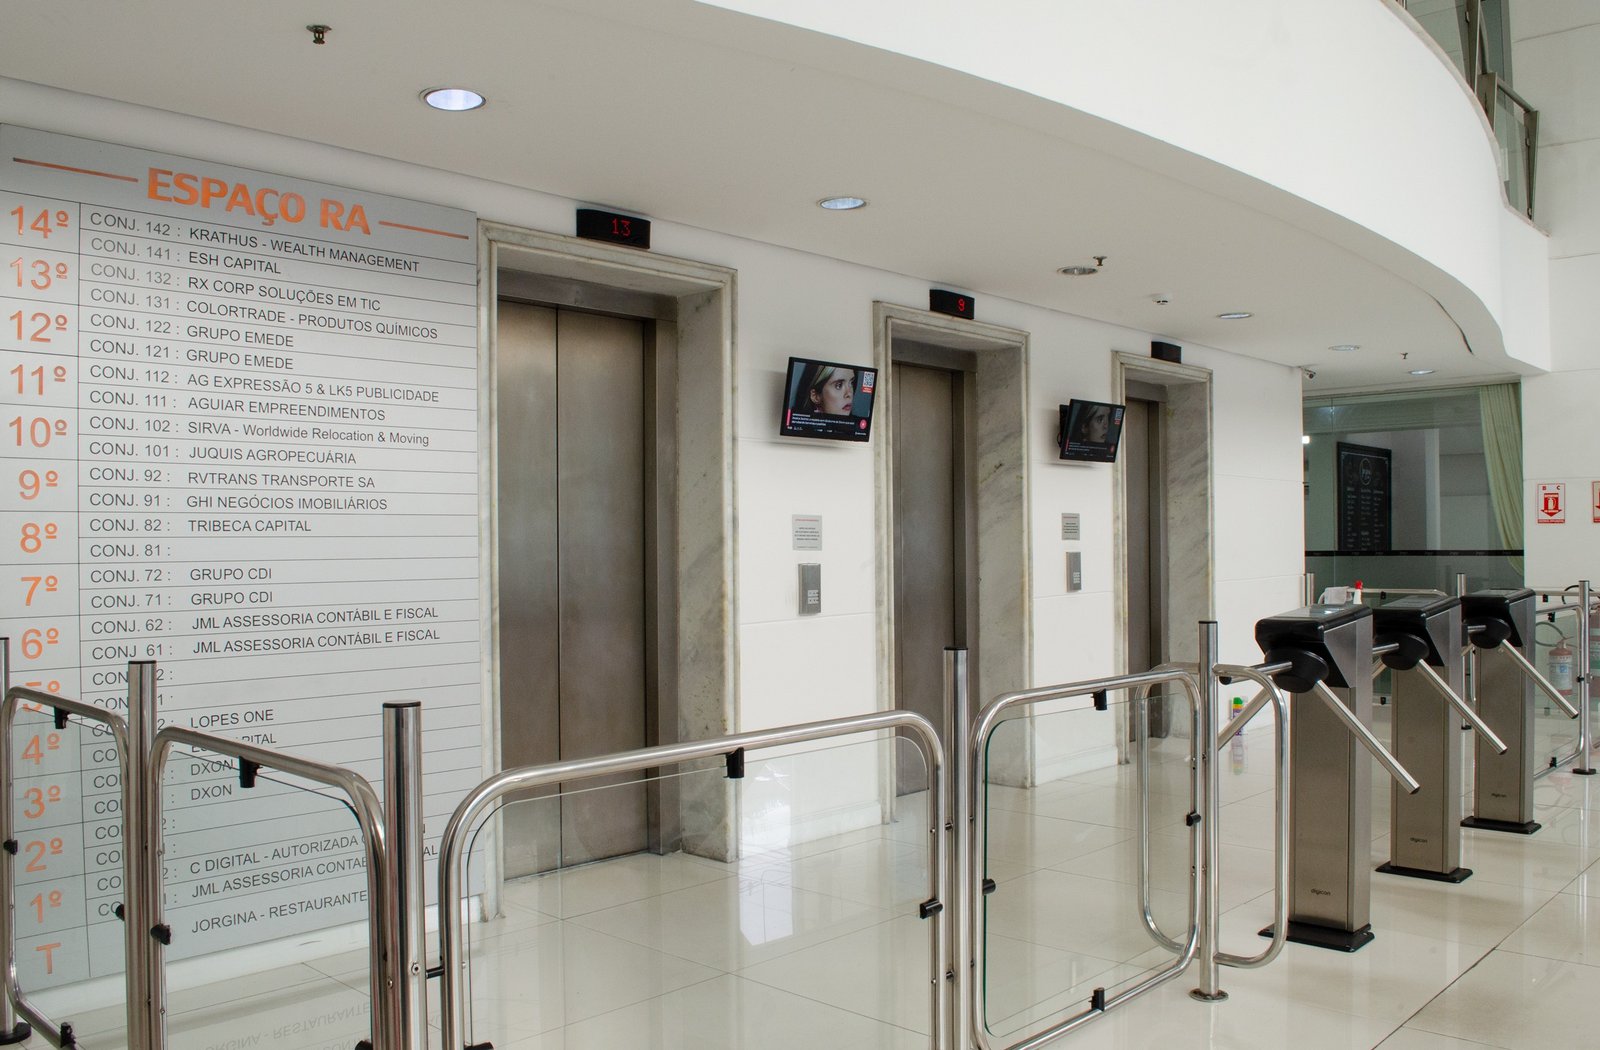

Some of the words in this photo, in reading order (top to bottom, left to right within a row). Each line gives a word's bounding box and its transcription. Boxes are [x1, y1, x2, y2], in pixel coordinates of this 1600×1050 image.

[148, 169, 305, 225] ESPAÇO
[320, 200, 370, 234] RA
[90, 212, 140, 231] CONJ.
[146, 221, 171, 236] 142
[189, 227, 258, 248] KRATHUS
[270, 239, 326, 258] WEALTH
[329, 248, 420, 272] MANAGEMENT
[611, 218, 631, 237] 13
[91, 237, 140, 256] CONJ.
[146, 246, 170, 260] 141
[189, 251, 221, 267] ESH
[223, 255, 282, 275] CAPITAL
[91, 263, 139, 281] CONJ.
[146, 270, 171, 285] 132
[188, 276, 212, 291] RX
[213, 280, 257, 295] CORP
[256, 285, 335, 305] SOLUÇÕES
[336, 295, 357, 308] EM
[360, 297, 381, 311] TIC
[90, 288, 139, 306] CONJ.
[146, 295, 169, 309] 131
[186, 300, 286, 324] COLORTRADE
[298, 313, 373, 333] PRODUTOS
[373, 321, 438, 341] QUÍMICOS
[957, 299, 965, 312] 9
[90, 313, 139, 331] CONJ.
[146, 319, 171, 334] 122
[186, 325, 241, 342] GRUPO
[244, 331, 294, 348] EMEDE
[90, 339, 139, 356] CONJ.
[145, 344, 169, 358] 121
[186, 349, 240, 365] GRUPO
[244, 354, 294, 370] EMEDE
[89, 364, 139, 381] CONJ.
[145, 370, 170, 383] 112
[187, 373, 209, 387] AG
[213, 375, 302, 394] EXPRESSÃO
[305, 383, 315, 395] 5
[314, 383, 326, 395] &
[329, 384, 353, 398] LK5
[354, 386, 439, 403] PUBLICIDADE
[89, 390, 139, 406] CONJ.
[145, 394, 166, 407] 111
[188, 397, 245, 412] AGUIAR
[247, 401, 386, 421] EMPREENDIMENTOS
[89, 416, 139, 431] CONJ.
[145, 418, 171, 433] 102
[188, 421, 231, 435] SIRVA
[242, 424, 310, 439] Worldwide
[312, 427, 374, 442] Relocation
[377, 431, 386, 443] &
[389, 432, 429, 448] Moving
[89, 441, 138, 456] CONJ.
[145, 444, 168, 457] 101
[189, 446, 245, 460] JUQUIS
[244, 449, 357, 464] AGROPECUÁRIA
[89, 467, 139, 482] CONJ.
[144, 469, 162, 482] 92
[188, 472, 258, 486] RVTRANS
[261, 474, 354, 488] TRANSPORTE
[358, 476, 375, 488] SA
[89, 492, 139, 507] CONJ.
[143, 494, 160, 507] 91
[186, 495, 213, 509] GHI
[217, 494, 295, 509] NEGÓCIOS
[298, 496, 388, 510] IMOBILIÁRIOS
[89, 518, 139, 532] CONJ.
[144, 518, 162, 532] 82
[187, 519, 252, 532] TRIBECA
[254, 519, 312, 532] CAPITAL
[90, 544, 139, 558] CONJ.
[144, 544, 160, 557] 81
[90, 569, 140, 583] CONJ.
[144, 568, 163, 582] 72
[190, 568, 246, 581] GRUPO
[247, 567, 272, 582] CDI
[91, 594, 140, 609] CONJ.
[145, 593, 161, 606] 71
[190, 591, 247, 606] GRUPO
[246, 591, 273, 606] CDI
[91, 619, 140, 635] CONJ.
[145, 618, 163, 632] 62
[192, 617, 221, 630] JML
[222, 612, 316, 628] ASSESSORIA
[316, 608, 381, 624] CONTÁBIL
[384, 609, 394, 620] E
[393, 607, 439, 622] FISCAL
[92, 645, 137, 660] CONJ
[146, 643, 162, 657] 61
[193, 641, 221, 654] JML
[223, 636, 315, 653] ASSESSORIA
[317, 631, 382, 648] CONTÁBIL
[385, 631, 394, 643] E
[396, 628, 440, 642] FISCAL
[191, 712, 239, 729] LOPES
[244, 709, 274, 722] ONE
[191, 759, 234, 776] DXON
[191, 784, 232, 801] DXON
[190, 862, 201, 874] C
[205, 852, 260, 872] DIGITAL
[272, 835, 359, 860] AUTORIZADA
[192, 883, 220, 898] JML
[222, 867, 314, 892] ASSESSORIA
[192, 910, 257, 934] JORGINA
[269, 890, 367, 918] RESTAURANTE
[36, 942, 62, 974] T
